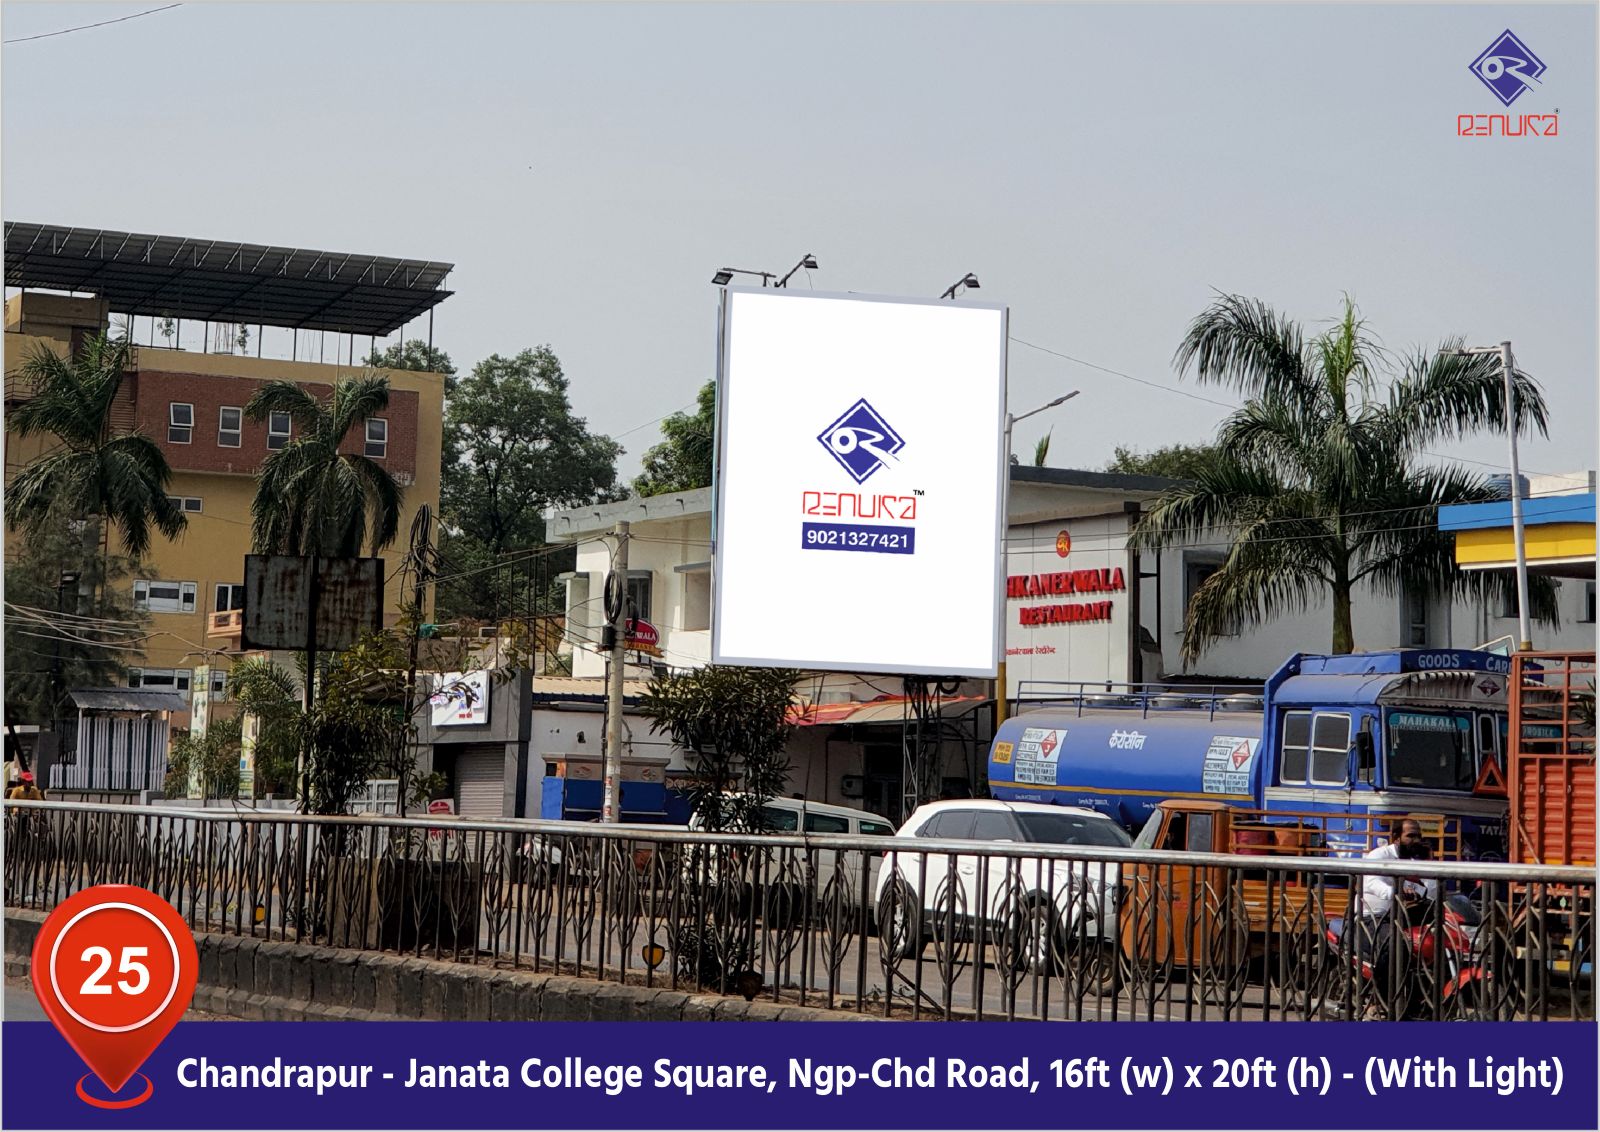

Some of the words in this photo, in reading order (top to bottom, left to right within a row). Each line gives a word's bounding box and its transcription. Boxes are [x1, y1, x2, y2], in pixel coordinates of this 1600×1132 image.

[806, 529, 908, 549] 9021327421
[1019, 600, 1112, 626] RESTAURANT
[1418, 654, 1460, 669] GOODS
